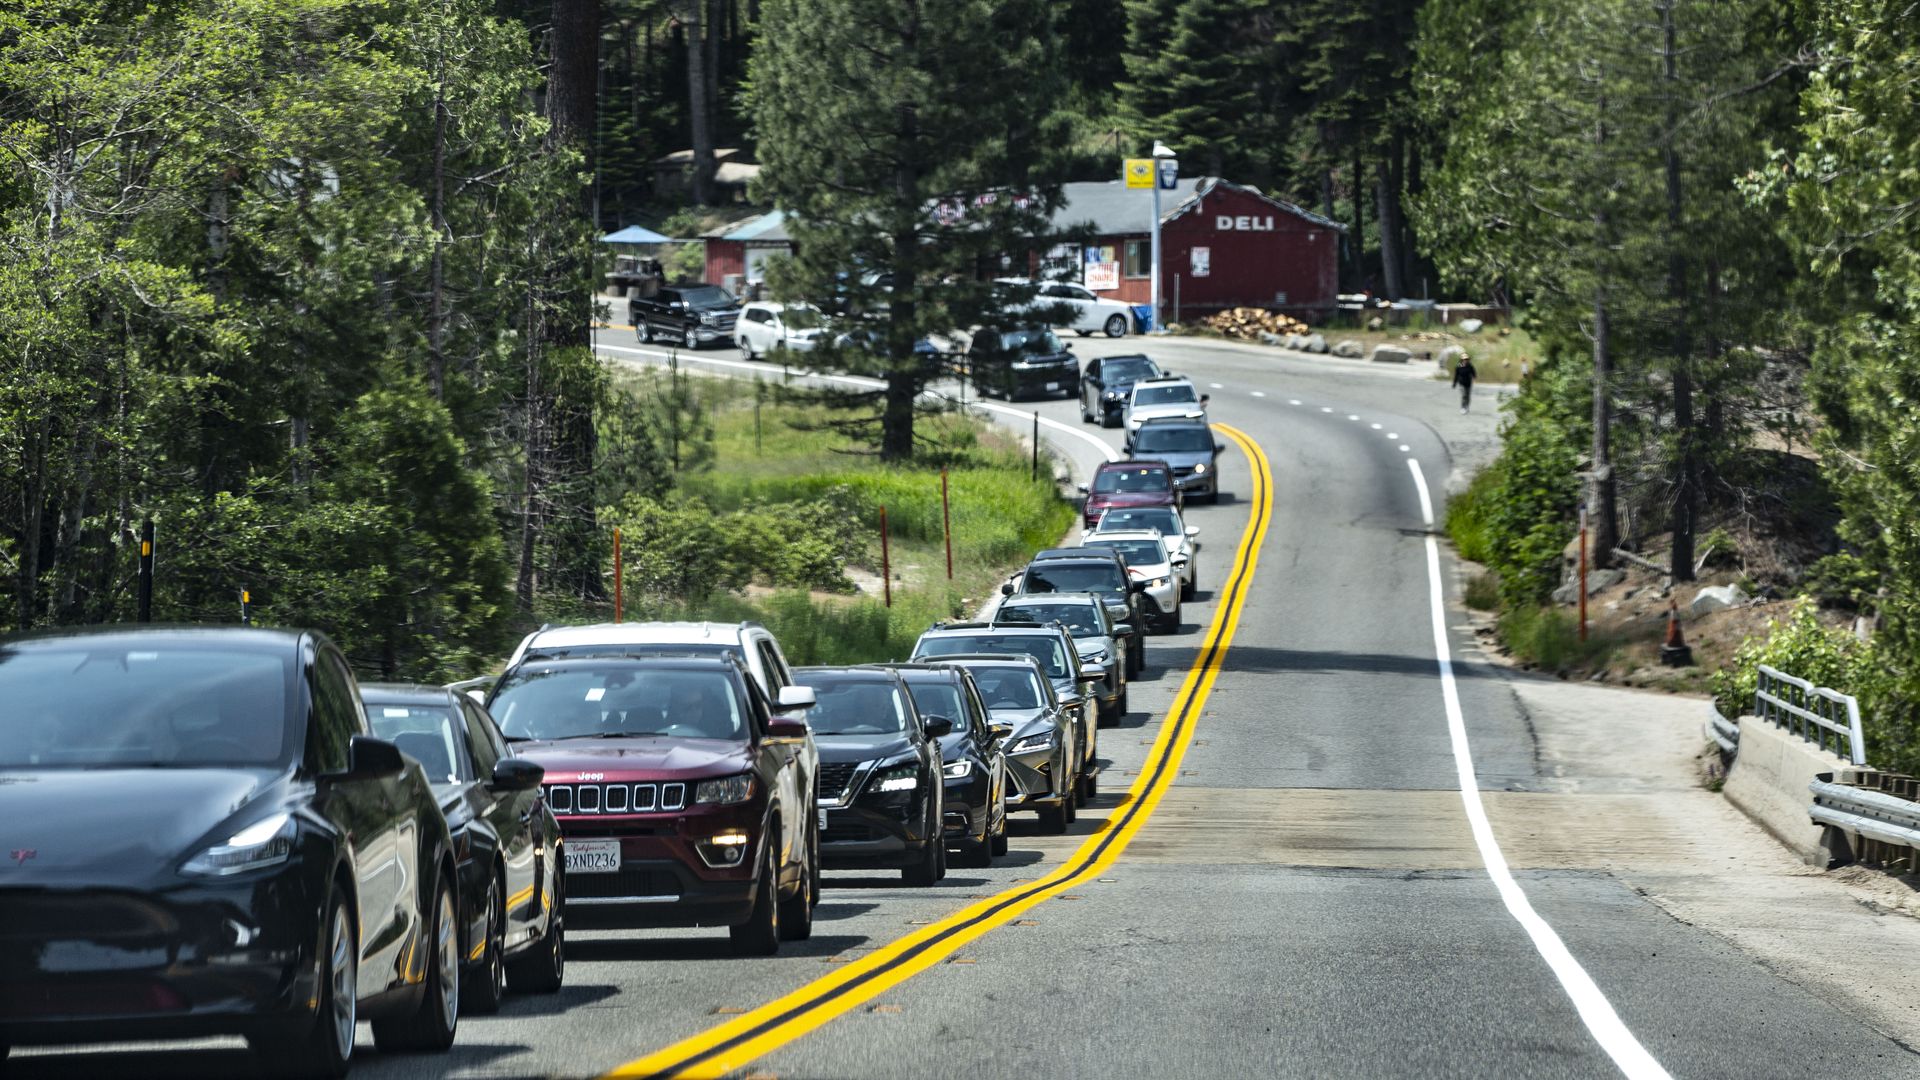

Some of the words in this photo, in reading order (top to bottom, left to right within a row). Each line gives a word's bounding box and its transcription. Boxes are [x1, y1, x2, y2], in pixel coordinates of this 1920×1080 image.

[1216, 215, 1274, 231] DELI
[577, 771, 604, 782] Jeep
[565, 853, 616, 869] 8XND236
